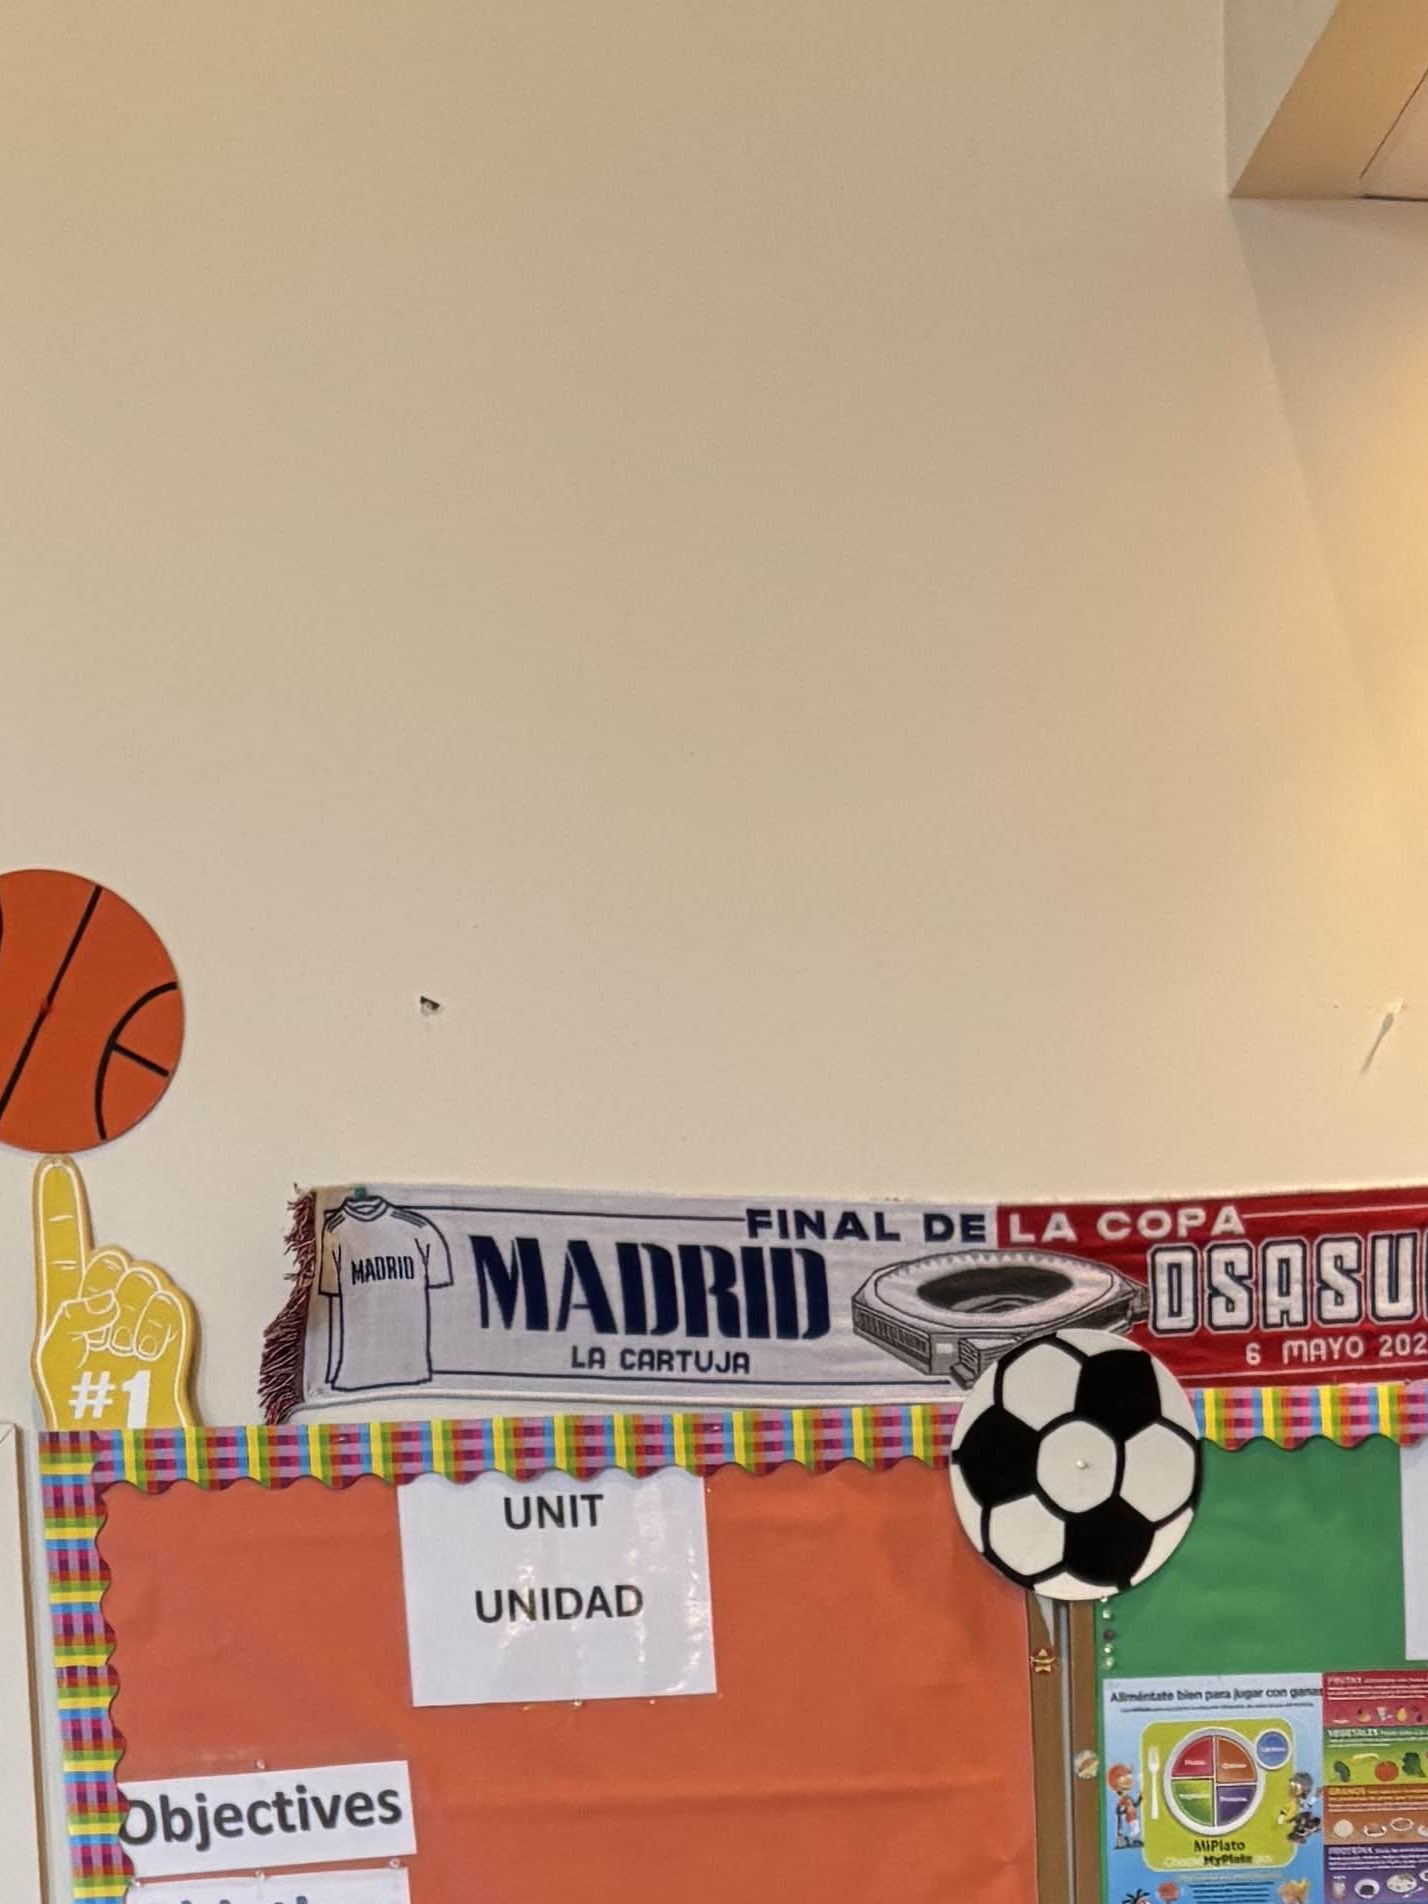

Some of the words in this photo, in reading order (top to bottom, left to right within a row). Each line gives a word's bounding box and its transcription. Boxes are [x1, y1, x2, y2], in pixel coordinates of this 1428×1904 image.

[745, 1208, 902, 1243] FINAL
[923, 1211, 988, 1244] DE
[1008, 1208, 1076, 1244] LA
[1096, 1204, 1247, 1240] COPA
[350, 1252, 416, 1285] MADRID
[469, 1233, 832, 1342] MADRID
[570, 1343, 608, 1371] LA
[619, 1346, 752, 1377] CARTUJA
[1245, 1342, 1263, 1368] 6
[1280, 1337, 1366, 1365] MAYO
[67, 1370, 152, 1430] #1
[503, 1493, 605, 1531] UNIT
[473, 1583, 645, 1625] UNIDAD
[1205, 1690, 1231, 1702] para
[1266, 1689, 1287, 1698] con
[118, 1783, 403, 1852] Objectives
